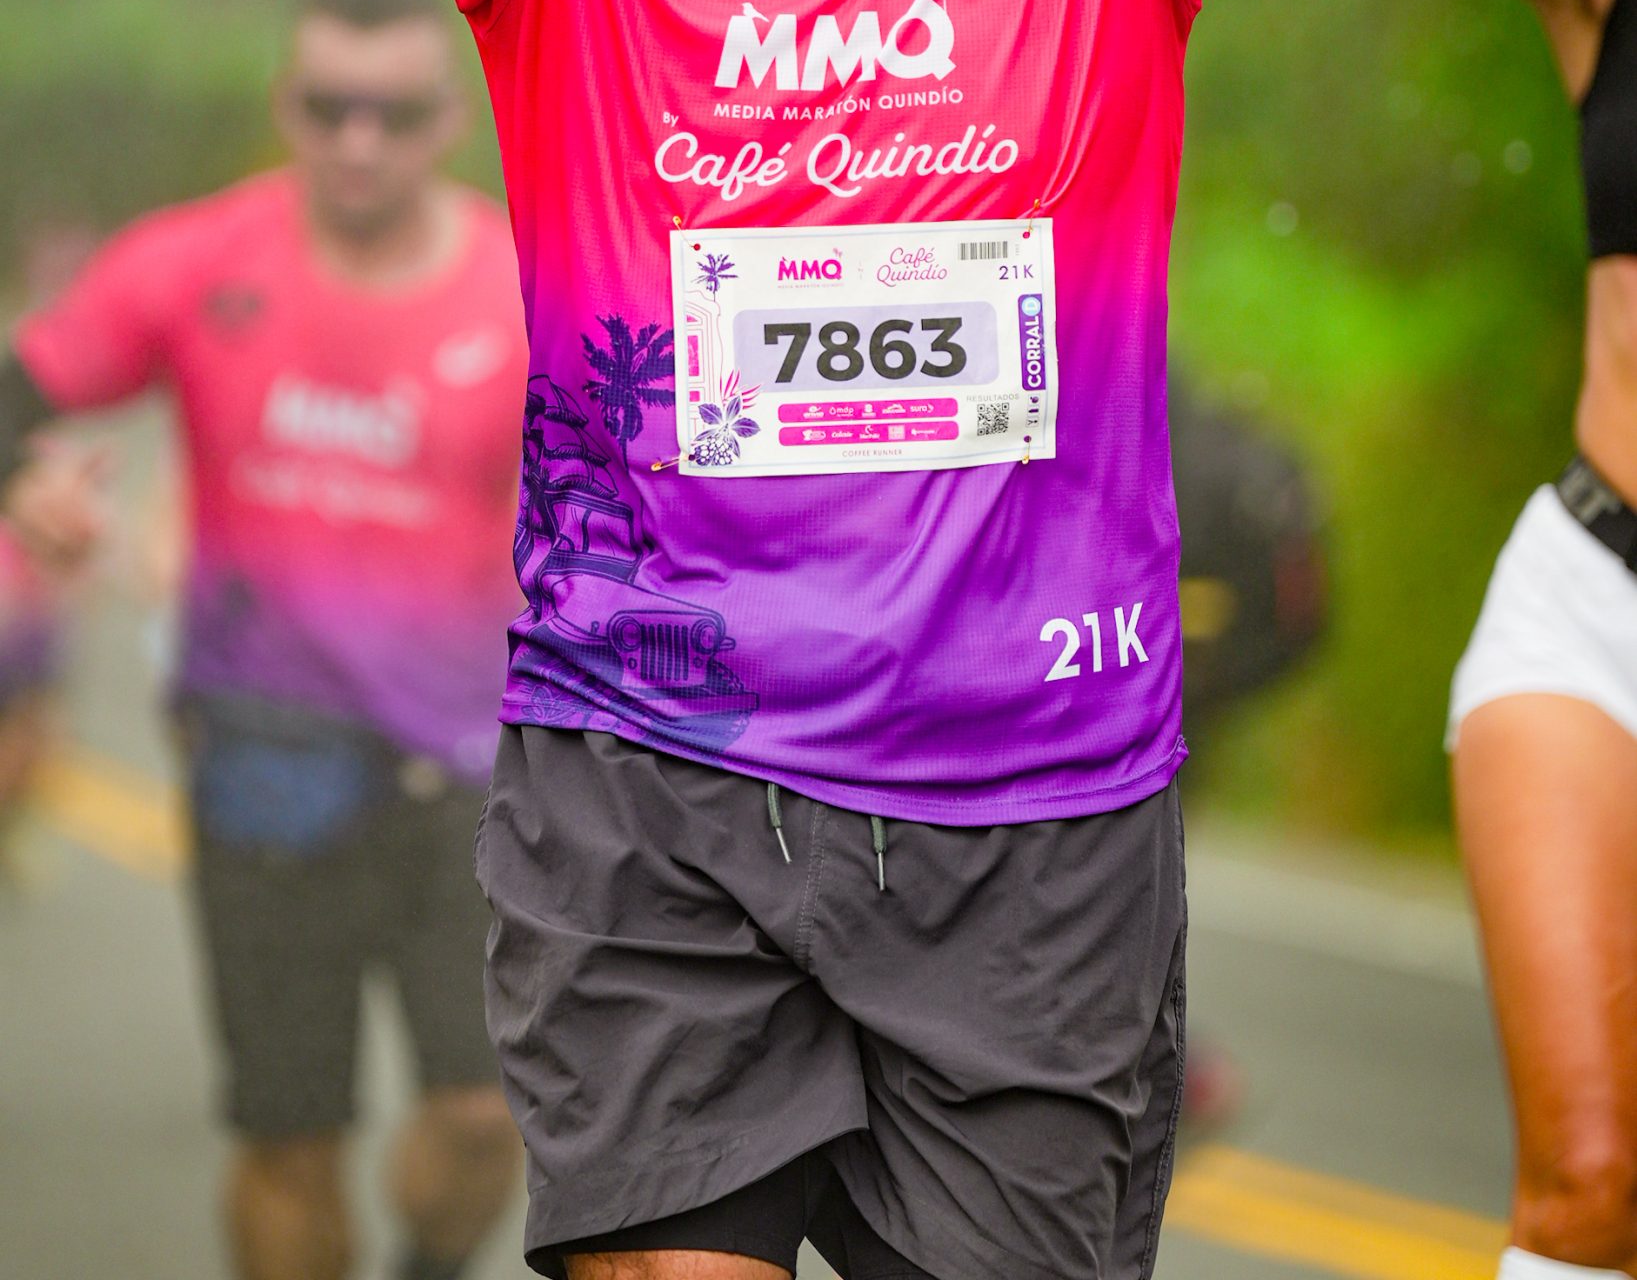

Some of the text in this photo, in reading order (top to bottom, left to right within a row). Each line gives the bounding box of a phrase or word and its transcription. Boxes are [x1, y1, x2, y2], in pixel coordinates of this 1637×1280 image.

[714, 103, 775, 120] MEDIA
[878, 86, 964, 110] QUINDÍO
[662, 111, 679, 128] By
[654, 123, 1020, 202] Café Quindío
[890, 246, 936, 268] Café
[778, 259, 842, 280] MMQ
[876, 264, 948, 288] Quindío
[999, 264, 1034, 280] 21K
[763, 317, 968, 384] 7863
[1025, 316, 1042, 388] CORRAL
[966, 393, 1020, 402] RESULTADOS
[842, 448, 903, 458] COFFEE RUNNER
[1039, 602, 1150, 682] 21K
